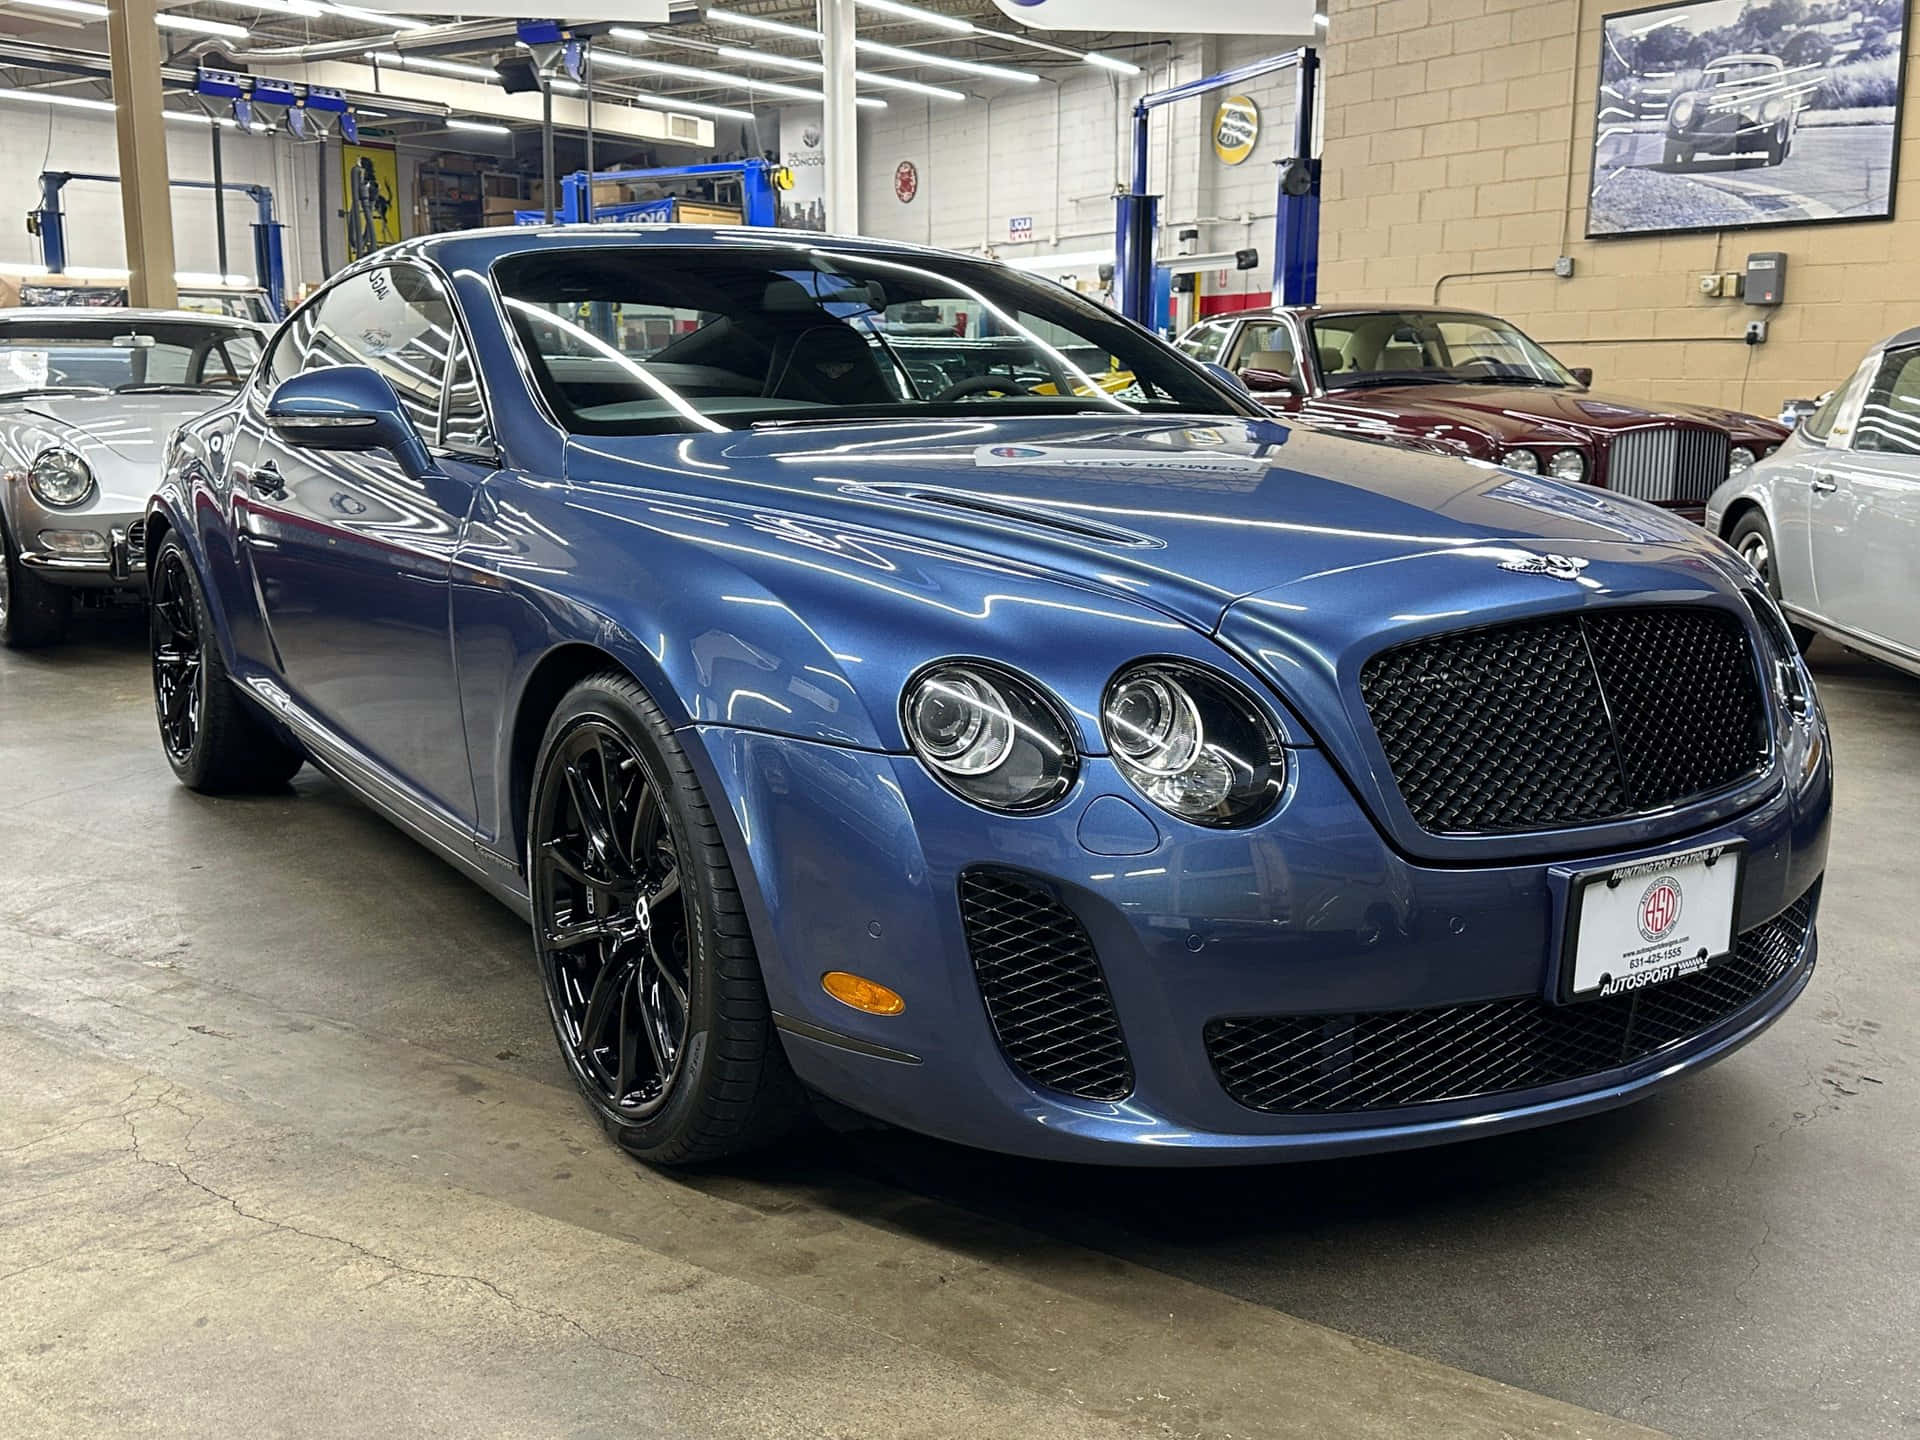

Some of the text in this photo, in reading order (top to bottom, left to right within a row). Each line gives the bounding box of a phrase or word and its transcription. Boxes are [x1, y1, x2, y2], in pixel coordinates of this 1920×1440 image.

[1611, 859, 1672, 880] HUNTINGTON
[1710, 846, 1725, 858] NY
[1629, 947, 1682, 969] 631-425-1555
[1600, 963, 1678, 996] AUTOSPORT
